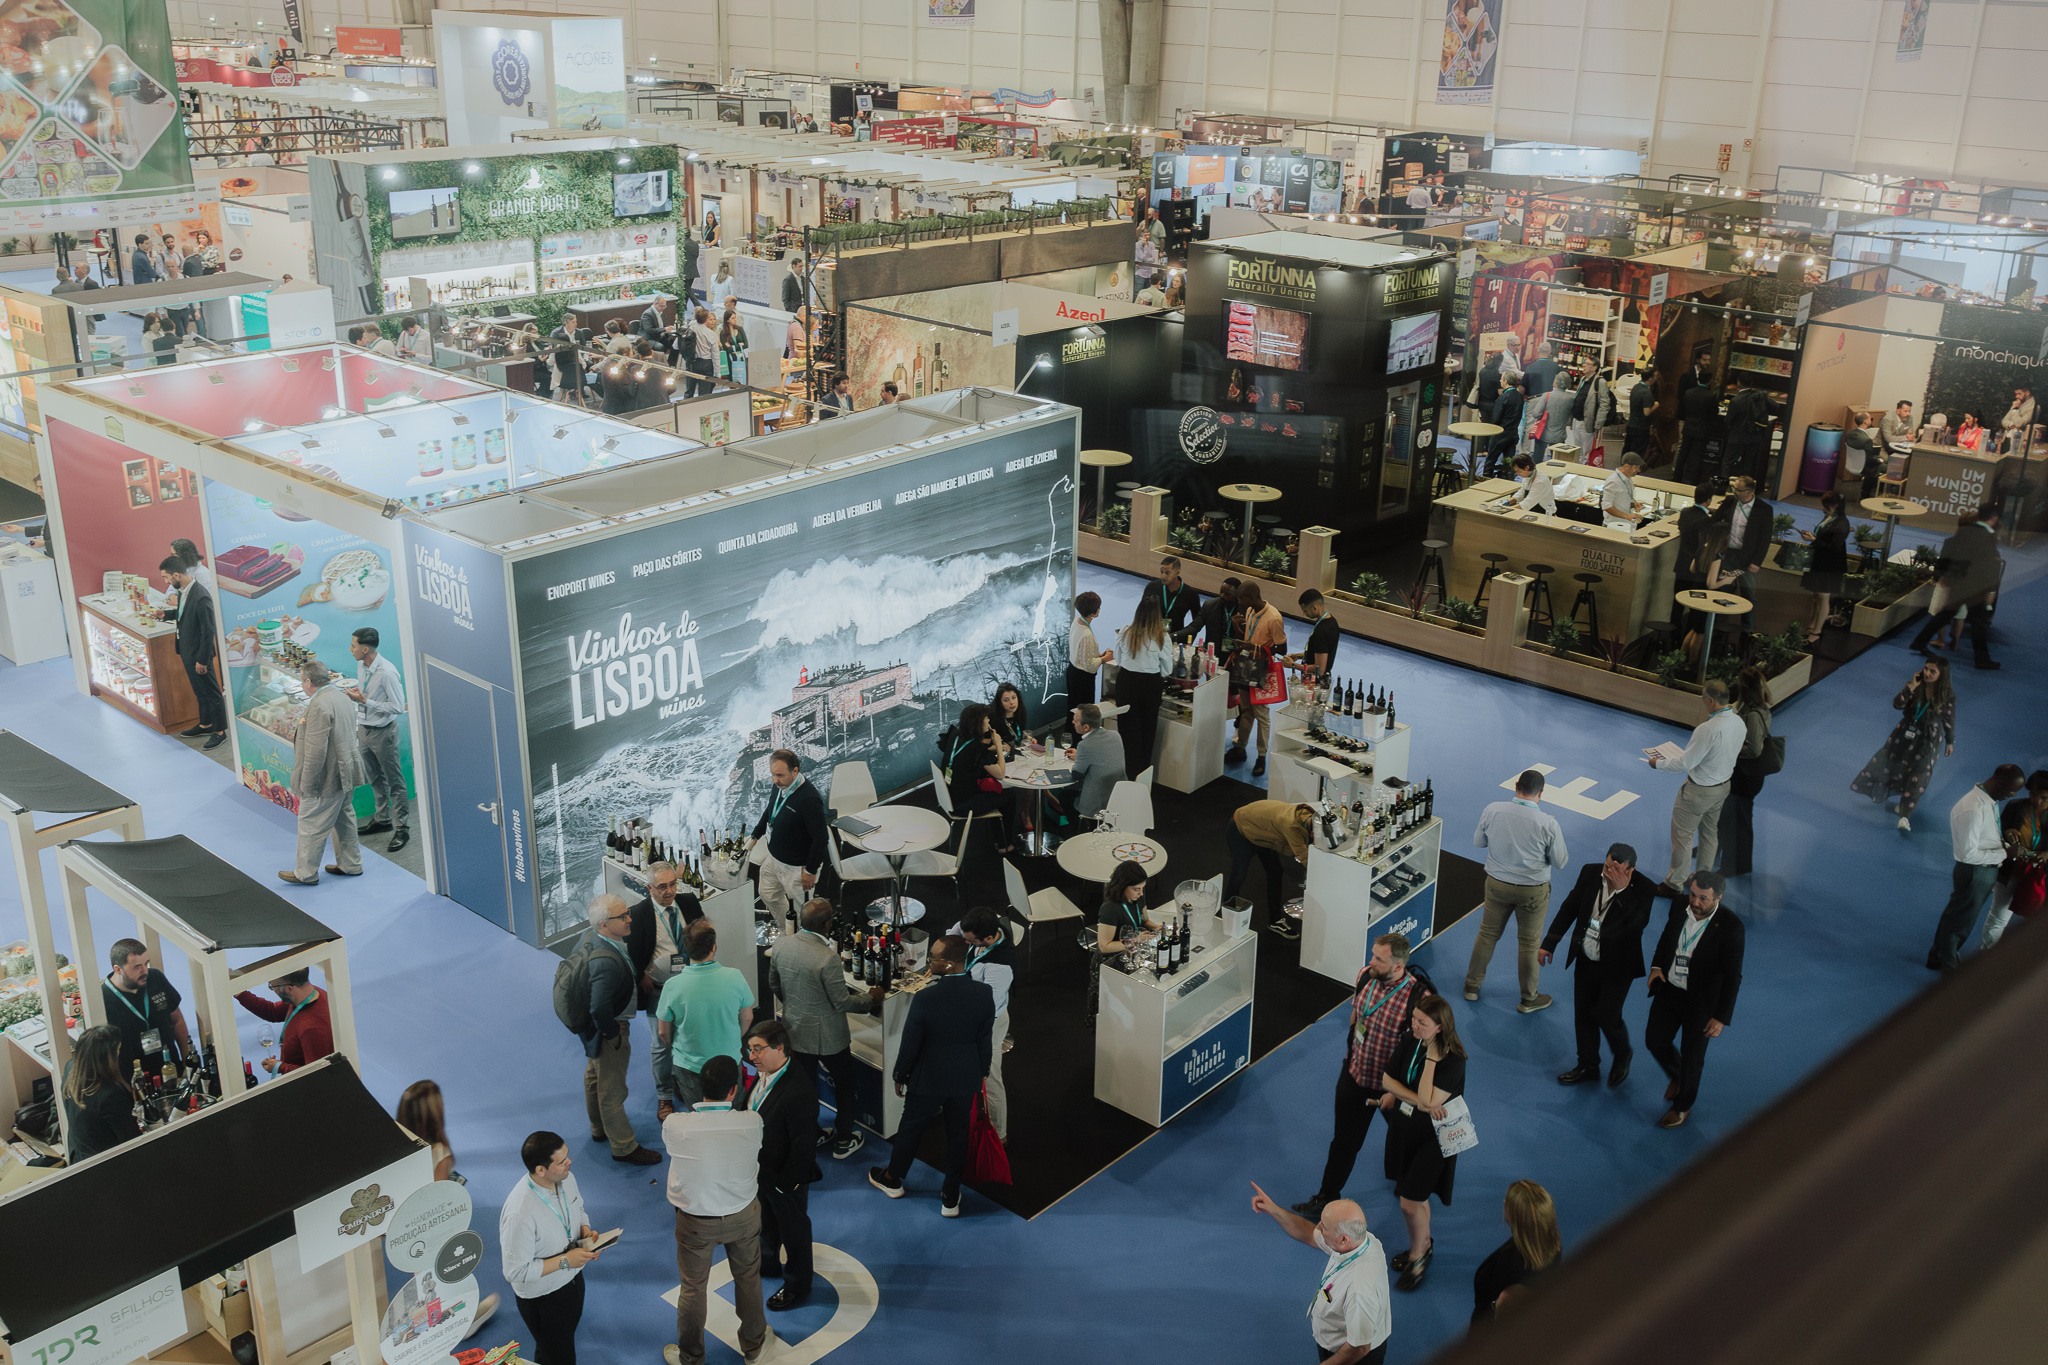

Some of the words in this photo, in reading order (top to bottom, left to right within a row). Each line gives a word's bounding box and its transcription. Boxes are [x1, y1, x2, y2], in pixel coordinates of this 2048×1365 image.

[564, 51, 614, 69] AÇORES
[1157, 160, 1173, 175] CA
[1290, 163, 1309, 178] CA
[489, 197, 537, 218] GRANDE
[540, 194, 579, 213] PORTO
[1228, 256, 1317, 290] FORTUNNA
[1384, 266, 1440, 294] FORTUNNA
[1228, 279, 1283, 297] Naturally
[1283, 287, 1316, 301] Unique
[1383, 290, 1416, 304] Naturally
[1416, 286, 1439, 299] Unique
[1056, 300, 1105, 322] Azeol
[1062, 336, 1106, 357] FORTUNNA
[1062, 352, 1087, 363] Naturally
[1087, 348, 1106, 358] Unique
[1183, 410, 1213, 432] SATISFACTION
[1190, 421, 1209, 436] PREMIUM
[1194, 438, 1223, 459] GUARANTEED
[1005, 459, 1025, 474] ADEGA
[1025, 456, 1033, 467] DE
[1033, 449, 1058, 466] AZUEIRA
[895, 489, 916, 506] ADEGA
[916, 484, 930, 500] SÃO
[930, 476, 957, 495] MAMEDE
[957, 474, 967, 487] DA
[966, 467, 994, 485] VENTOSA
[1925, 475, 1984, 496] MUNDO
[1961, 468, 1986, 484] UM
[1948, 491, 1982, 507] SEM
[812, 511, 836, 529] ADEGA
[836, 509, 847, 522] DA
[846, 498, 882, 520] VERMELHA
[231, 532, 267, 544] GOIABADA
[311, 536, 334, 547] CREME
[336, 534, 353, 542] COM
[718, 536, 746, 554] QUINTA
[746, 533, 757, 546] DA
[757, 522, 798, 544] CIDADOURA
[415, 543, 457, 579] Vinhos
[457, 566, 469, 585] de
[632, 560, 654, 578] PAÇO
[655, 555, 672, 571] DAS
[672, 547, 703, 567] CÔRTES
[1581, 558, 1598, 570] FOOD
[1599, 562, 1624, 576] SAFETY
[1582, 548, 1626, 567] QUALITY
[416, 565, 473, 620] LISBOA
[547, 578, 587, 601] ENOPORT
[587, 570, 616, 590] WINES
[237, 610, 255, 621] DOCE
[257, 608, 267, 616] DE
[267, 604, 285, 614] LEITE
[453, 614, 475, 631] wines
[568, 611, 672, 672] Vinhos
[675, 609, 700, 639] de
[570, 637, 704, 730] LISBOA
[658, 693, 706, 720] wines
[512, 809, 526, 883] #lisboawines
[1447, 1128, 1464, 1138] EXPO
[411, 1201, 446, 1227] HANDMADE
[390, 1223, 428, 1249] PRODUÇÃO
[428, 1202, 468, 1230] ARTESANAL
[443, 1261, 461, 1275] Since
[461, 1253, 477, 1267] 1994
[110, 1284, 174, 1323] &FILHOS
[444, 1316, 470, 1334] PORTUGAL
[31, 1324, 101, 1365] JDR
